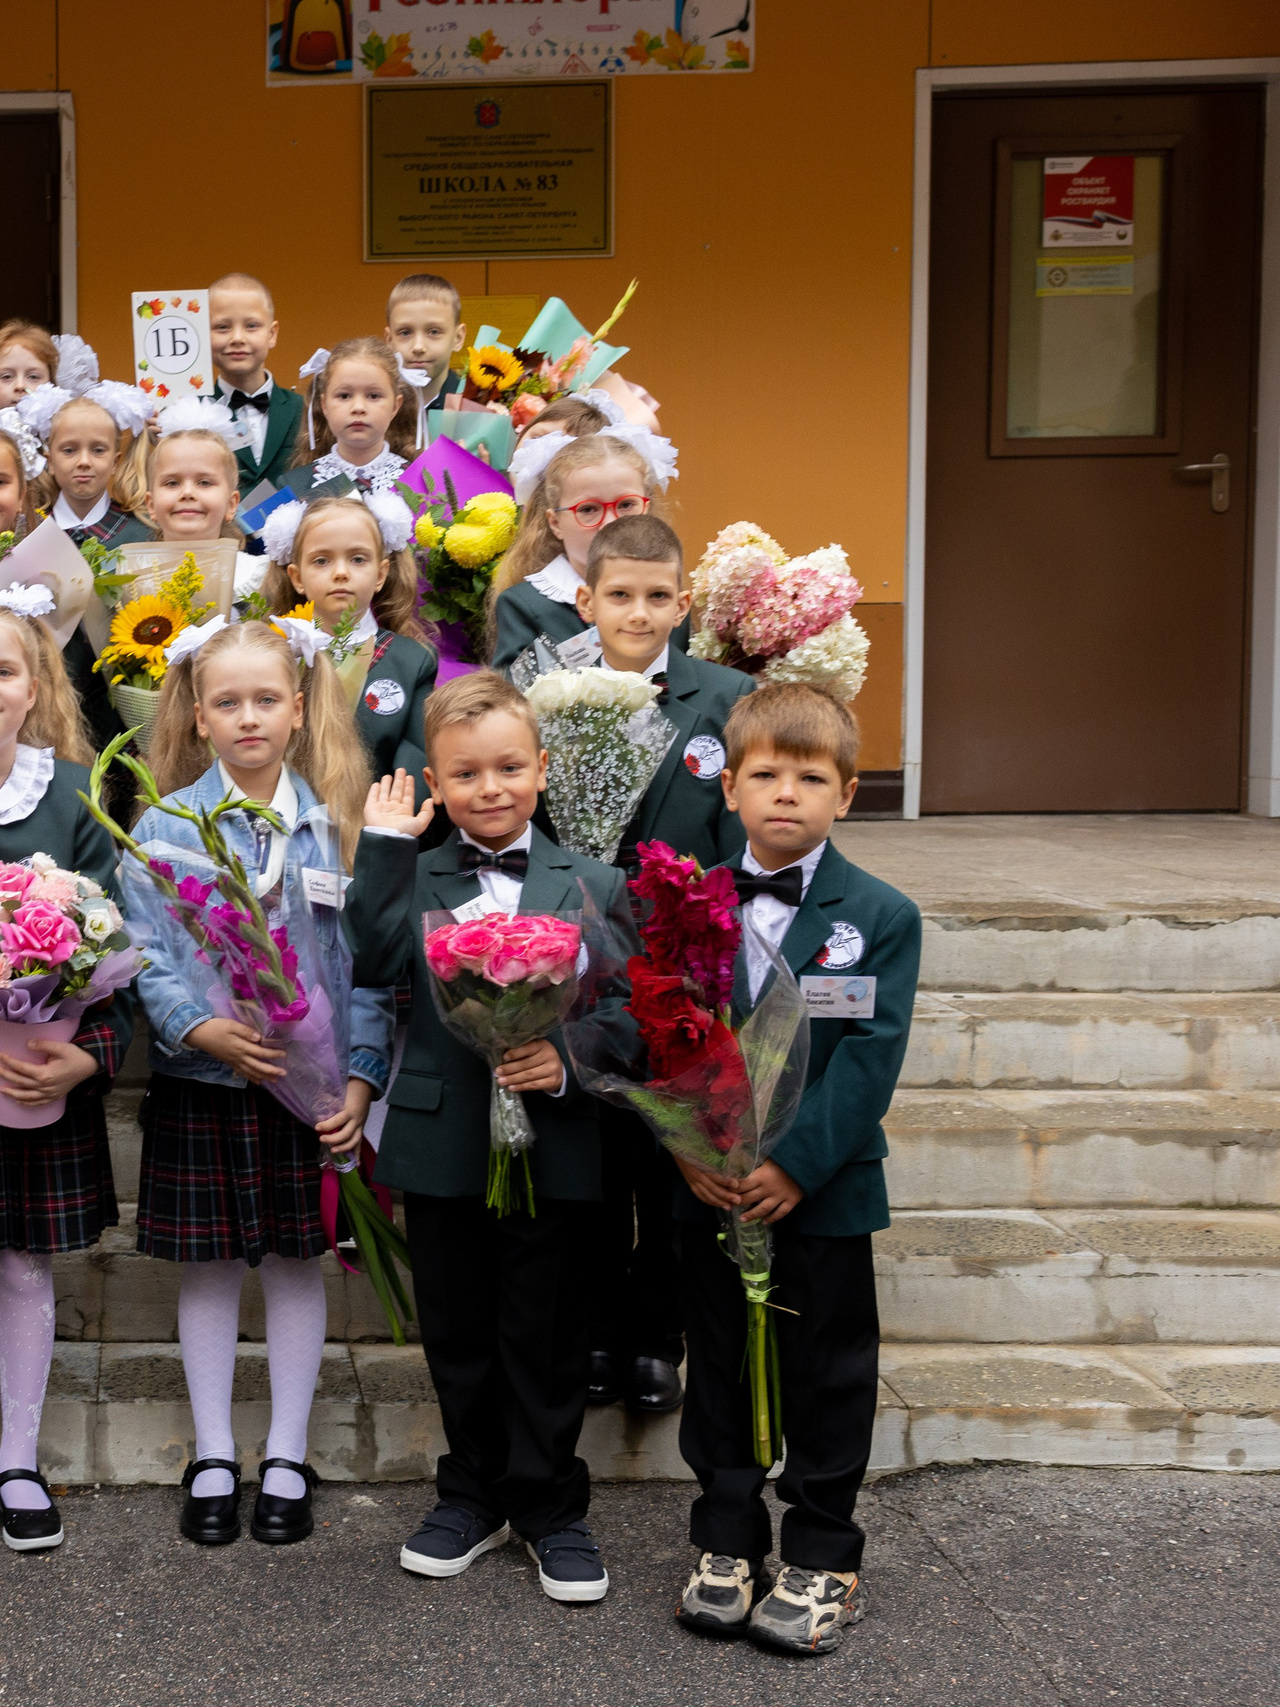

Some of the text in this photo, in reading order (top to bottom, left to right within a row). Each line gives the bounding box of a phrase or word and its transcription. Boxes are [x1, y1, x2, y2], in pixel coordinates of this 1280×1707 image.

[403, 160, 573, 171] СРЕДНЯЯ ОБЩЕОБРАЗОВАТЕЛЬНАЯ
[419, 174, 558, 194] ШКОЛА № 83
[1060, 196, 1117, 206] РОСГВАРДИЯ
